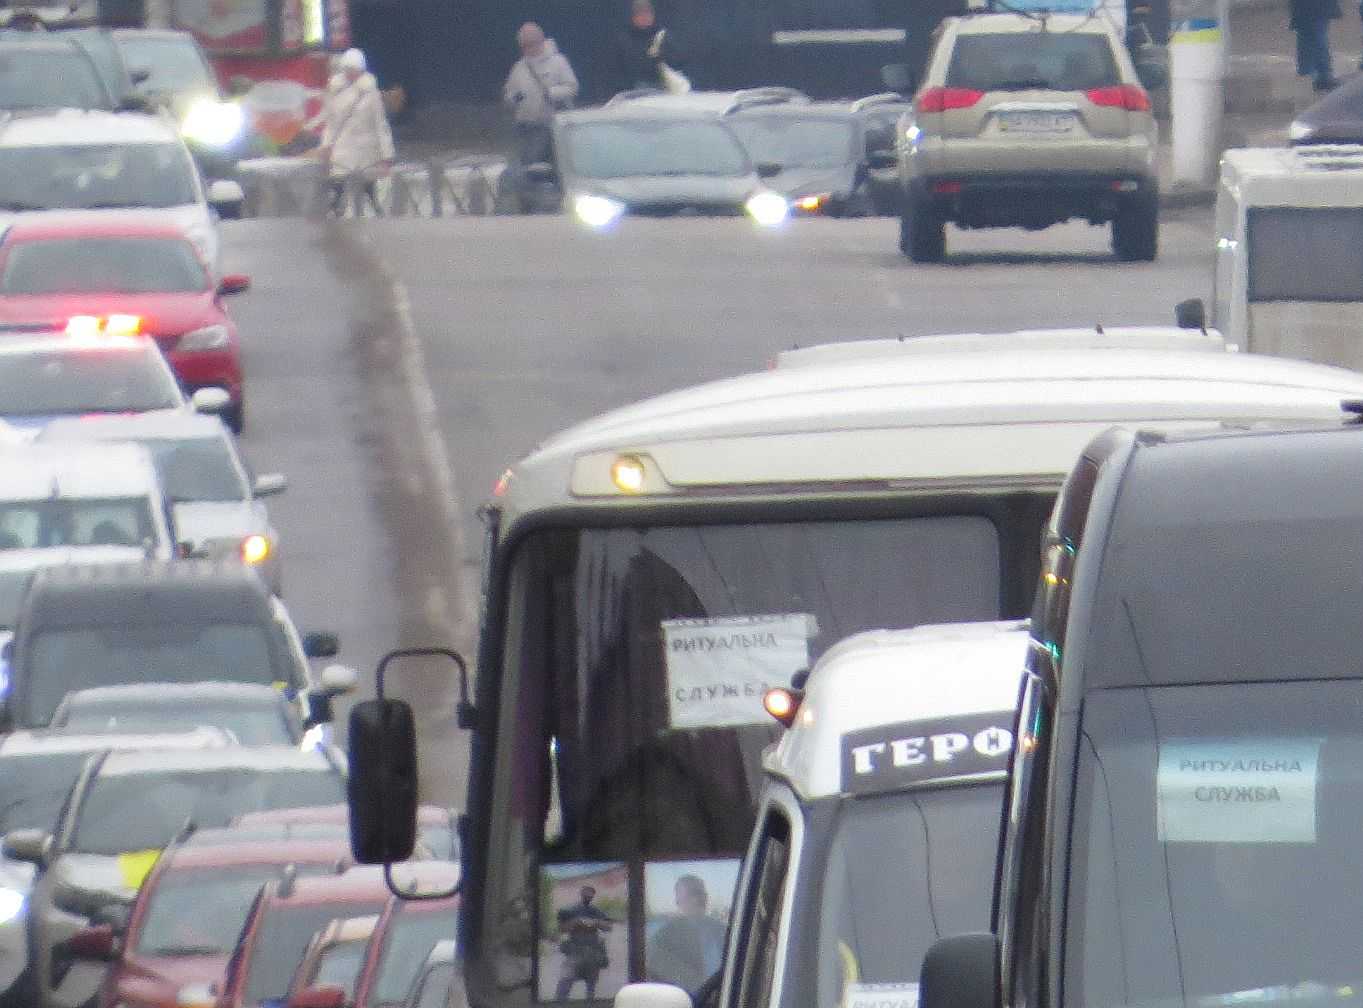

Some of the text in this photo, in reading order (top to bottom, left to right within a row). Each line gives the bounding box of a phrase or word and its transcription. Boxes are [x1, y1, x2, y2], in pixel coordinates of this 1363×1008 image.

[672, 632, 779, 652] РИТУАЛЬНА
[1179, 759, 1302, 772] РИТУАЛЬНА
[1194, 786, 1281, 801] СЛУЖБА
